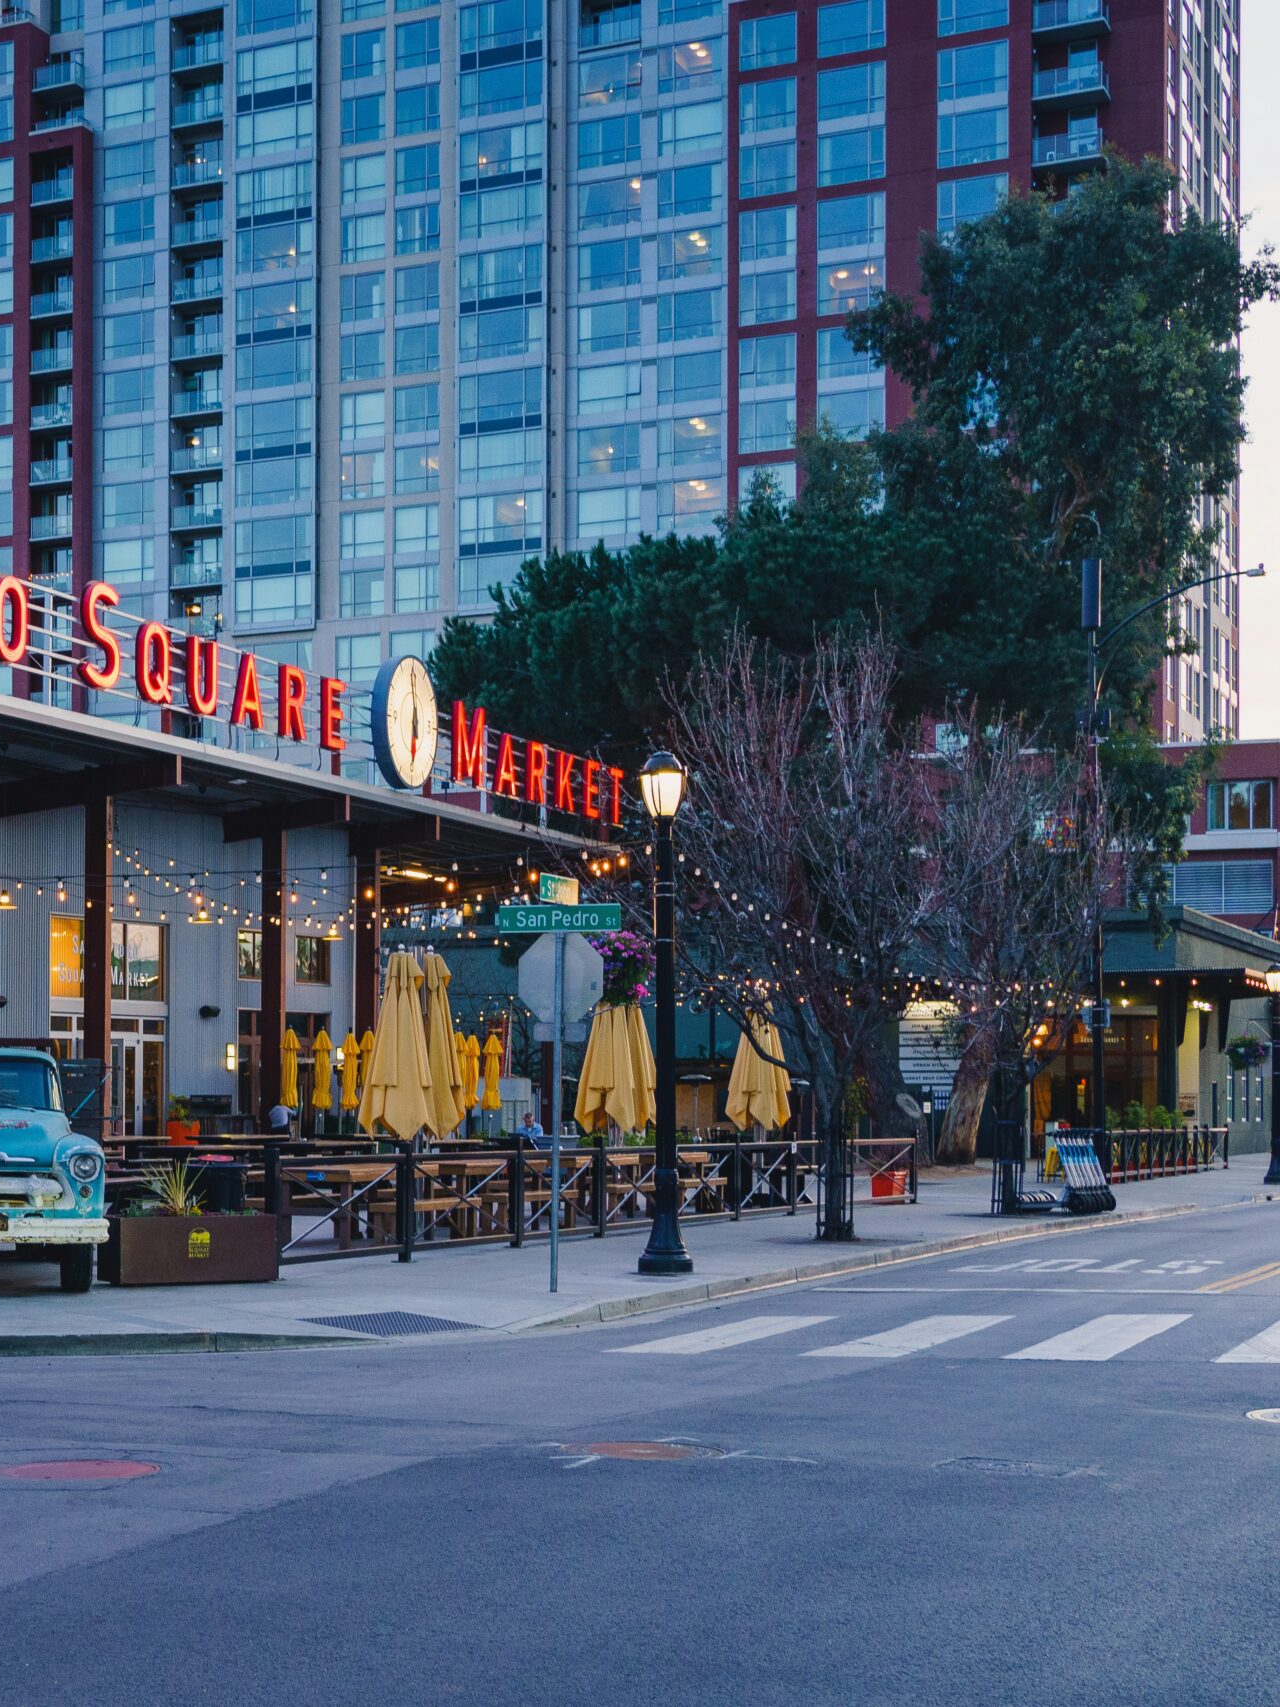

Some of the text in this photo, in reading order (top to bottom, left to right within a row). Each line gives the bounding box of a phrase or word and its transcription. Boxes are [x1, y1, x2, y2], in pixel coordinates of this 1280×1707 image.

[77, 580, 348, 752] SQUARE
[451, 699, 625, 828] MARKET
[547, 879, 555, 897] St
[503, 910, 616, 928] N San Pedro St
[59, 961, 149, 988] SQUA MARKET
